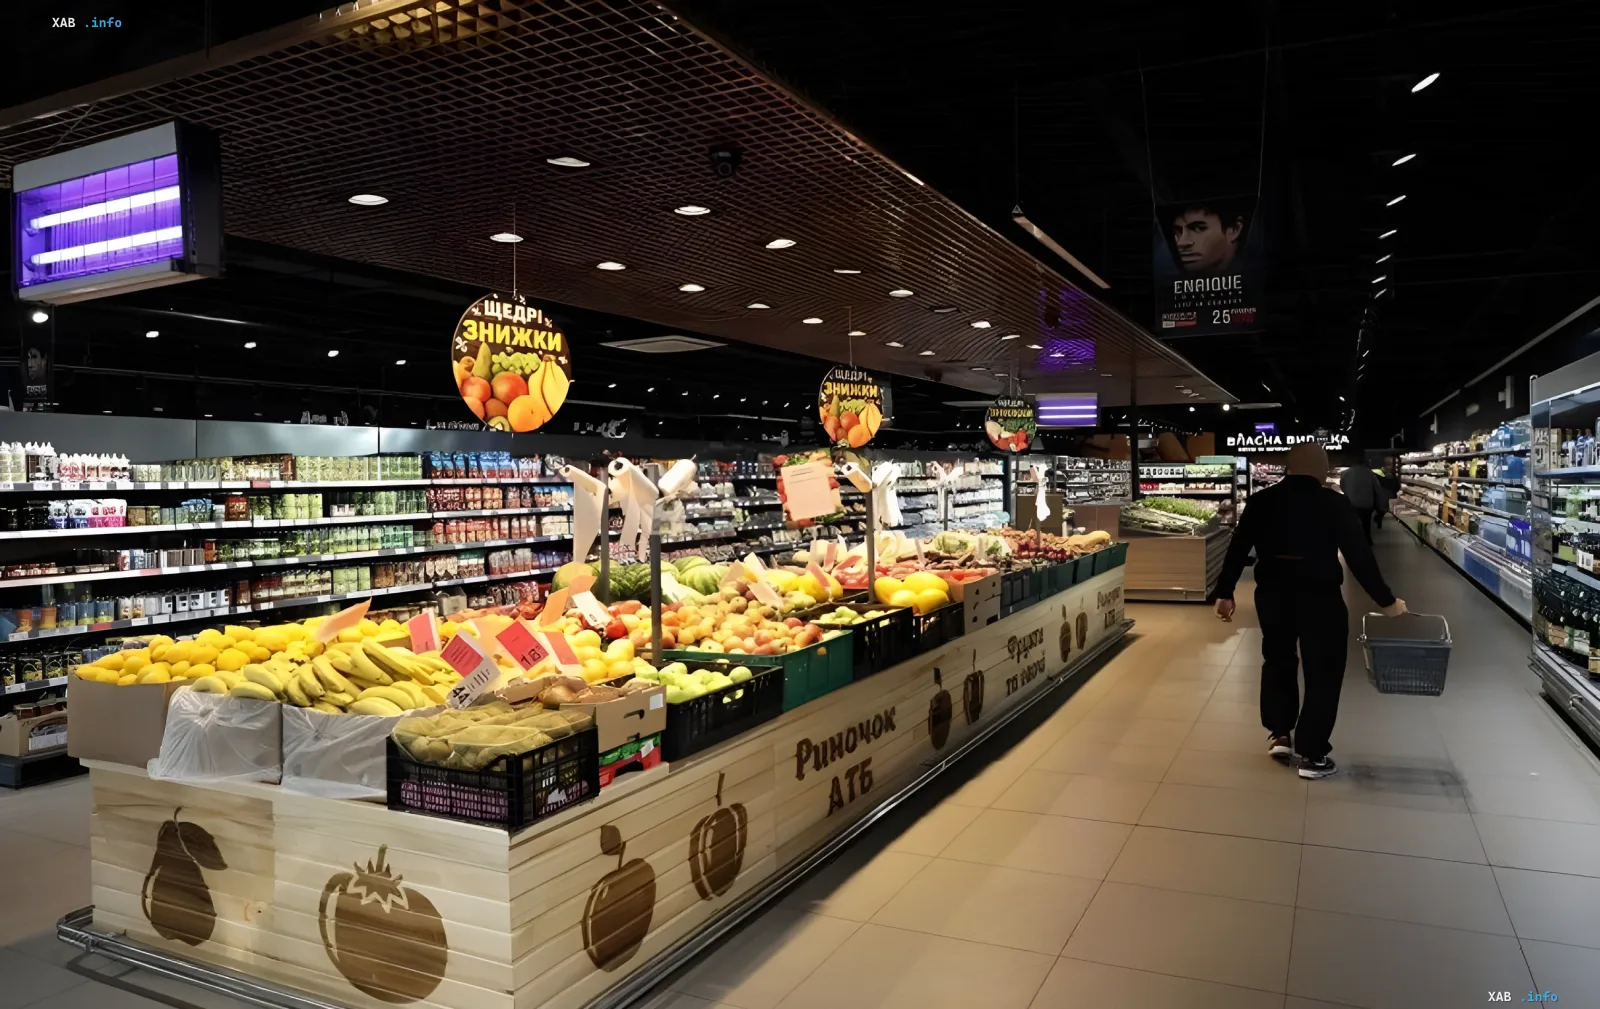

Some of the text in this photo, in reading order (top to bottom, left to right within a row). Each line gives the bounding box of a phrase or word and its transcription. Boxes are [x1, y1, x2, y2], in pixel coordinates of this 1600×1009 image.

[484, 299, 543, 325] ЩЕДРІ
[462, 319, 562, 352] ЗНИЖКИ
[823, 381, 878, 398] ЗНИЖКИ
[1286, 434, 1350, 446] ВИПКА
[795, 706, 896, 781] Риночок
[826, 756, 874, 818] АТБ
